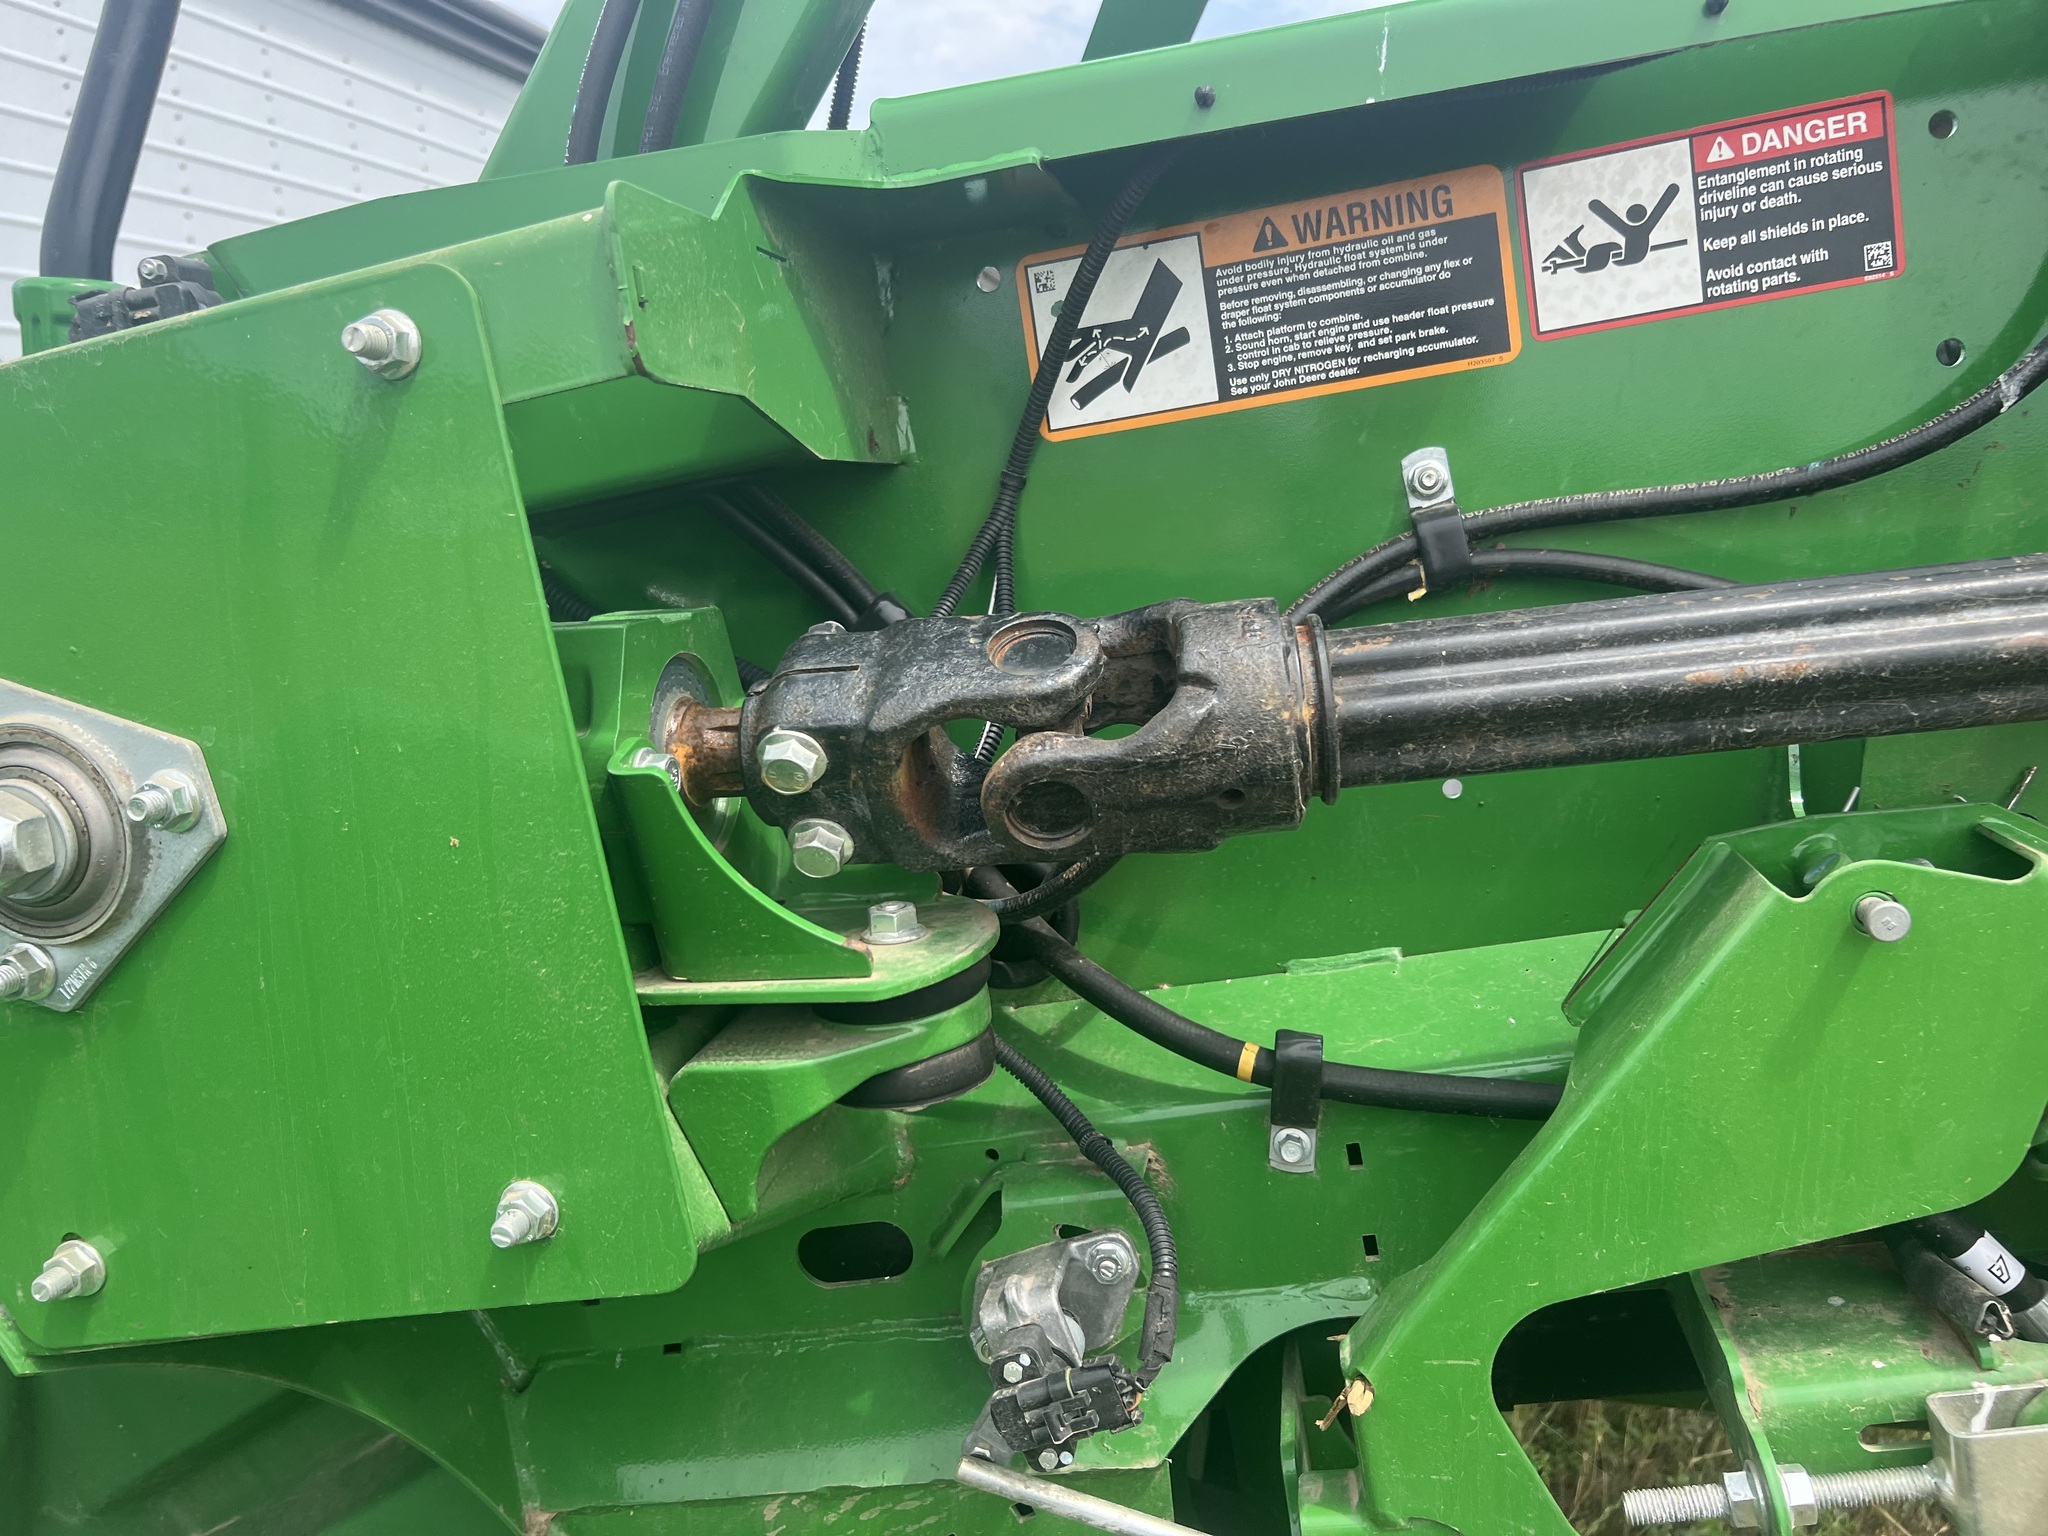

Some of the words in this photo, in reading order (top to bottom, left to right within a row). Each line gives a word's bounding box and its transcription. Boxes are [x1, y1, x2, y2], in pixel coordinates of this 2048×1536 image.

[1742, 111, 1867, 156] DANGER
[1697, 159, 1790, 190] Entanglement
[1793, 157, 1806, 171] in
[1809, 147, 1863, 168] rotating
[1698, 184, 1756, 204] driveline
[1759, 179, 1784, 193] can
[1787, 171, 1828, 188] cause
[1831, 160, 1883, 179] serious
[1291, 184, 1453, 244] WARNING
[1699, 204, 1738, 222] injury
[1741, 200, 1756, 213] or
[1759, 191, 1801, 209] death.
[1215, 264, 1242, 277] Avoid
[1244, 258, 1274, 271] bodily
[1276, 253, 1305, 266] injury
[1307, 248, 1330, 259] from
[1332, 238, 1378, 257] hydraulic
[1381, 235, 1393, 245] oil
[1396, 231, 1415, 242] and
[1417, 229, 1437, 240] gas
[1702, 235, 1737, 252] Keep
[1740, 228, 1756, 244] all
[1759, 221, 1808, 241] shields
[1811, 218, 1824, 231] in
[1828, 212, 1869, 231] place.
[1216, 274, 1244, 286] under
[1246, 266, 1293, 283] pressure.
[1294, 254, 1341, 272] Hydraulic
[1343, 250, 1366, 262] float
[1368, 244, 1405, 258] system
[1406, 241, 1416, 250] is
[1418, 236, 1447, 248] under
[1217, 282, 1258, 298] pressure
[1260, 277, 1283, 287] even
[1284, 270, 1310, 283] when
[1312, 261, 1356, 278] detached
[1357, 257, 1380, 269] from
[1382, 250, 1427, 265] combine.
[1705, 262, 1743, 281] Avoid
[1746, 253, 1797, 274] contact
[1799, 248, 1828, 264] with
[1219, 299, 1249, 311] Before
[1250, 290, 1296, 307] removing,
[1296, 277, 1365, 296] disassembling,
[1366, 275, 1377, 283] or
[1378, 266, 1423, 280] changing
[1424, 263, 1442, 276] any
[1442, 258, 1460, 269] flex
[1461, 257, 1472, 265] or
[1220, 308, 1251, 322] draper
[1251, 302, 1272, 314] float
[1273, 297, 1306, 311] system
[1307, 285, 1365, 303] components
[1366, 284, 1377, 293] or
[1378, 272, 1436, 290] accumulator
[1437, 270, 1451, 279] do
[1706, 278, 1758, 297] rotating
[1761, 270, 1800, 290] parts.
[1221, 320, 1236, 329] the
[1236, 310, 1281, 326] following:
[1223, 335, 1232, 344] 1.
[1234, 329, 1264, 342] Attach
[1266, 322, 1305, 339] platform
[1306, 320, 1317, 329] to
[1318, 312, 1363, 326] combine.
[1224, 344, 1233, 353] 2.
[1234, 337, 1265, 351] Sound
[1266, 335, 1292, 346] horn,
[1293, 329, 1316, 341] start
[1317, 324, 1350, 338] engine
[1351, 318, 1370, 330] and
[1372, 317, 1389, 326] use
[1391, 310, 1425, 323] header
[1426, 304, 1449, 316] float
[1450, 298, 1494, 314] pressure
[1227, 363, 1236, 372] 3.
[1237, 360, 1259, 370] Stop
[1261, 353, 1296, 366] engine,
[1297, 347, 1332, 359] remove
[1334, 341, 1353, 353] key,
[1357, 336, 1375, 348] and
[1377, 334, 1393, 345] set
[1394, 330, 1416, 344] park
[1418, 326, 1448, 337] brake.
[1228, 376, 1247, 386] Use
[1249, 372, 1269, 383] only
[1271, 367, 1291, 379] DRY
[1293, 357, 1345, 375] NITROGEN
[1347, 356, 1361, 365] for
[1363, 346, 1414, 362] recharging
[1416, 335, 1478, 353] accumulator.
[1236, 346, 1269, 361] control
[1271, 345, 1281, 354] in
[1282, 341, 1300, 352] cab
[1301, 340, 1312, 349] to
[1313, 334, 1345, 347] relieve
[1347, 327, 1392, 343] pressure.
[1230, 386, 1248, 395] See
[1249, 381, 1271, 394] your
[1272, 377, 1296, 388] John
[1298, 372, 1326, 383] Deere
[1328, 366, 1359, 378] dealer.
